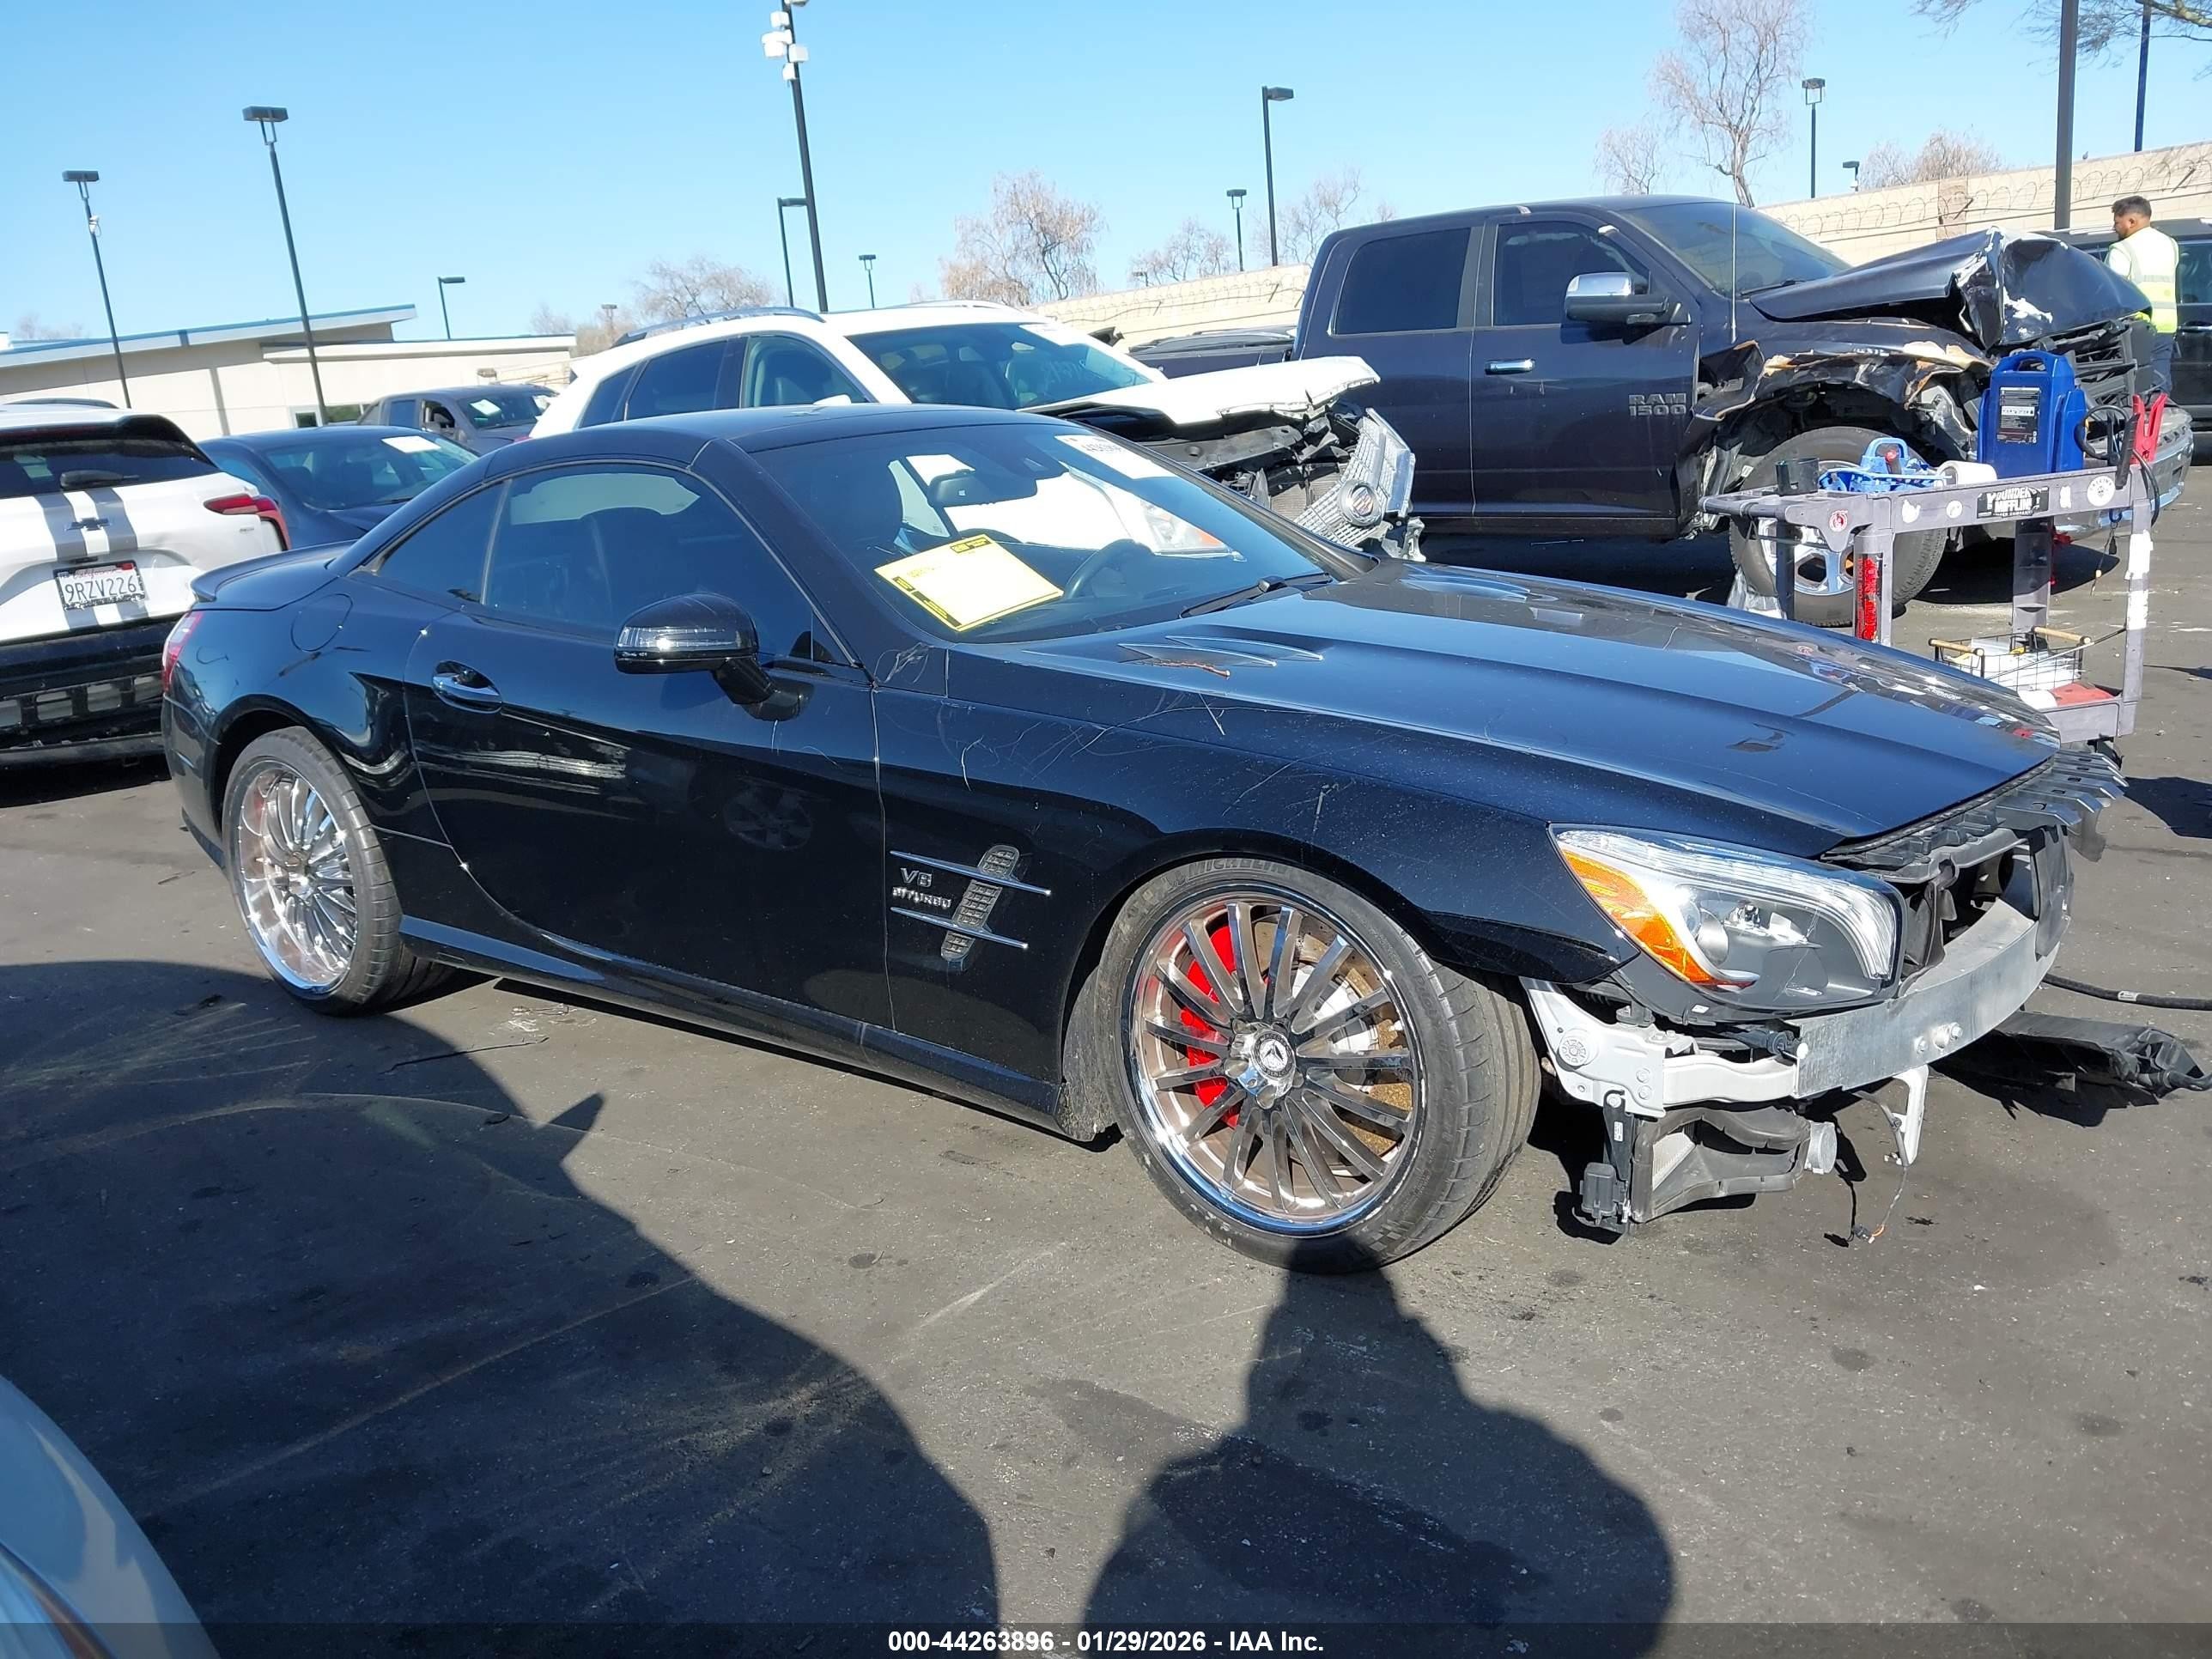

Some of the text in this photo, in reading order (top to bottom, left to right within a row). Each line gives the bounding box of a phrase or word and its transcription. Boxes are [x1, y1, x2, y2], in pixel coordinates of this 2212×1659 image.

[1628, 392, 1686, 404] RAM
[1628, 404, 1686, 416] 1500
[1994, 497, 2033, 513] MIFFLIN
[65, 576, 137, 602] 9RZV226
[1188, 859, 1288, 876] MICHELIN
[901, 867, 933, 888] V8
